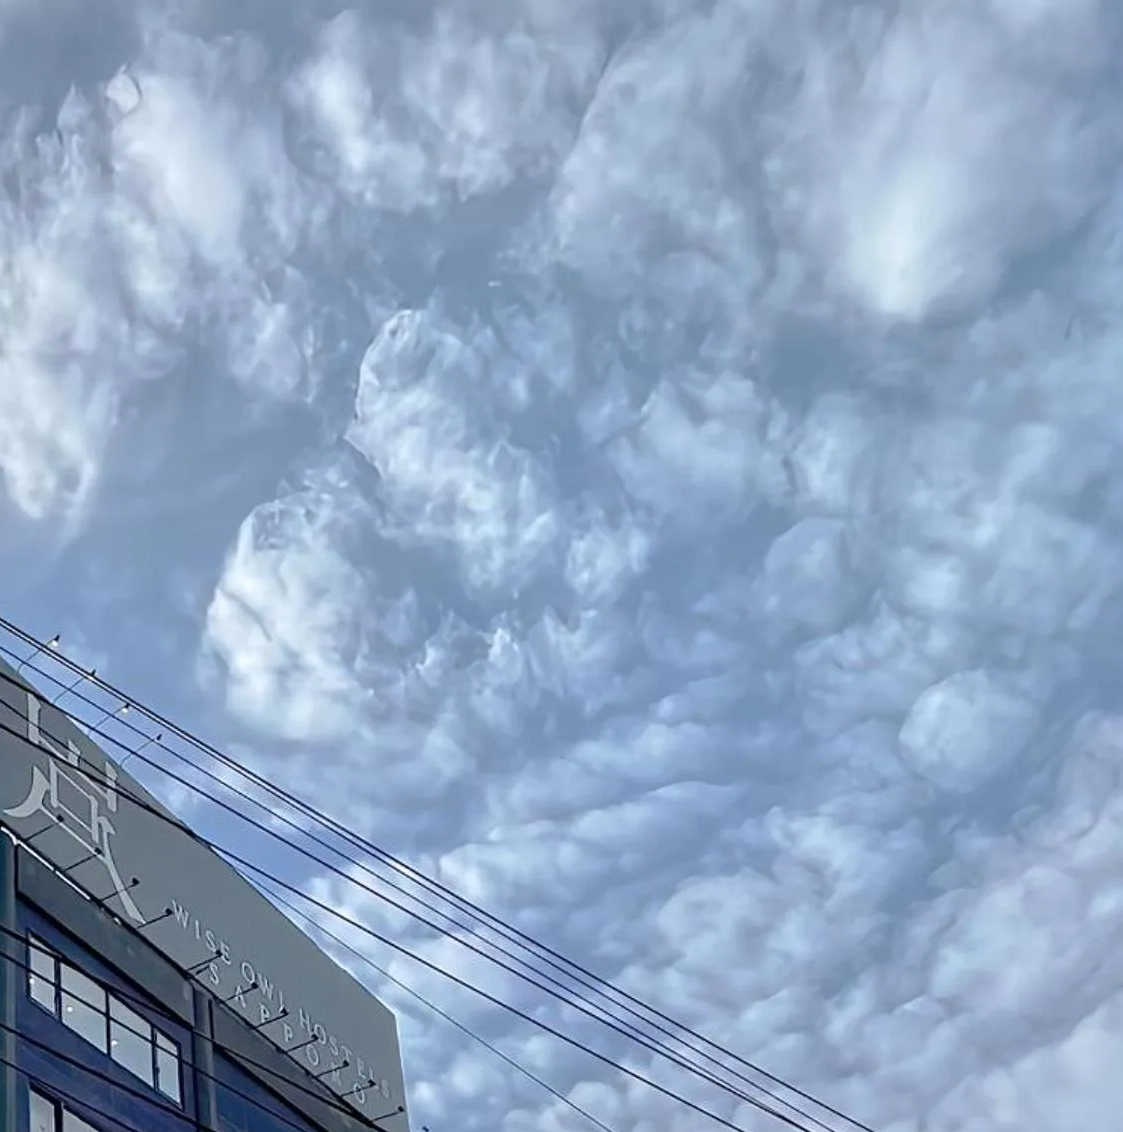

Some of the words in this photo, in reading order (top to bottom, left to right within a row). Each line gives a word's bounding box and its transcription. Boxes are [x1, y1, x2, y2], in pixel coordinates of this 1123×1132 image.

[173, 900, 231, 964] WISE
[241, 961, 286, 1014] OWL
[209, 963, 366, 1104] SAPPORO
